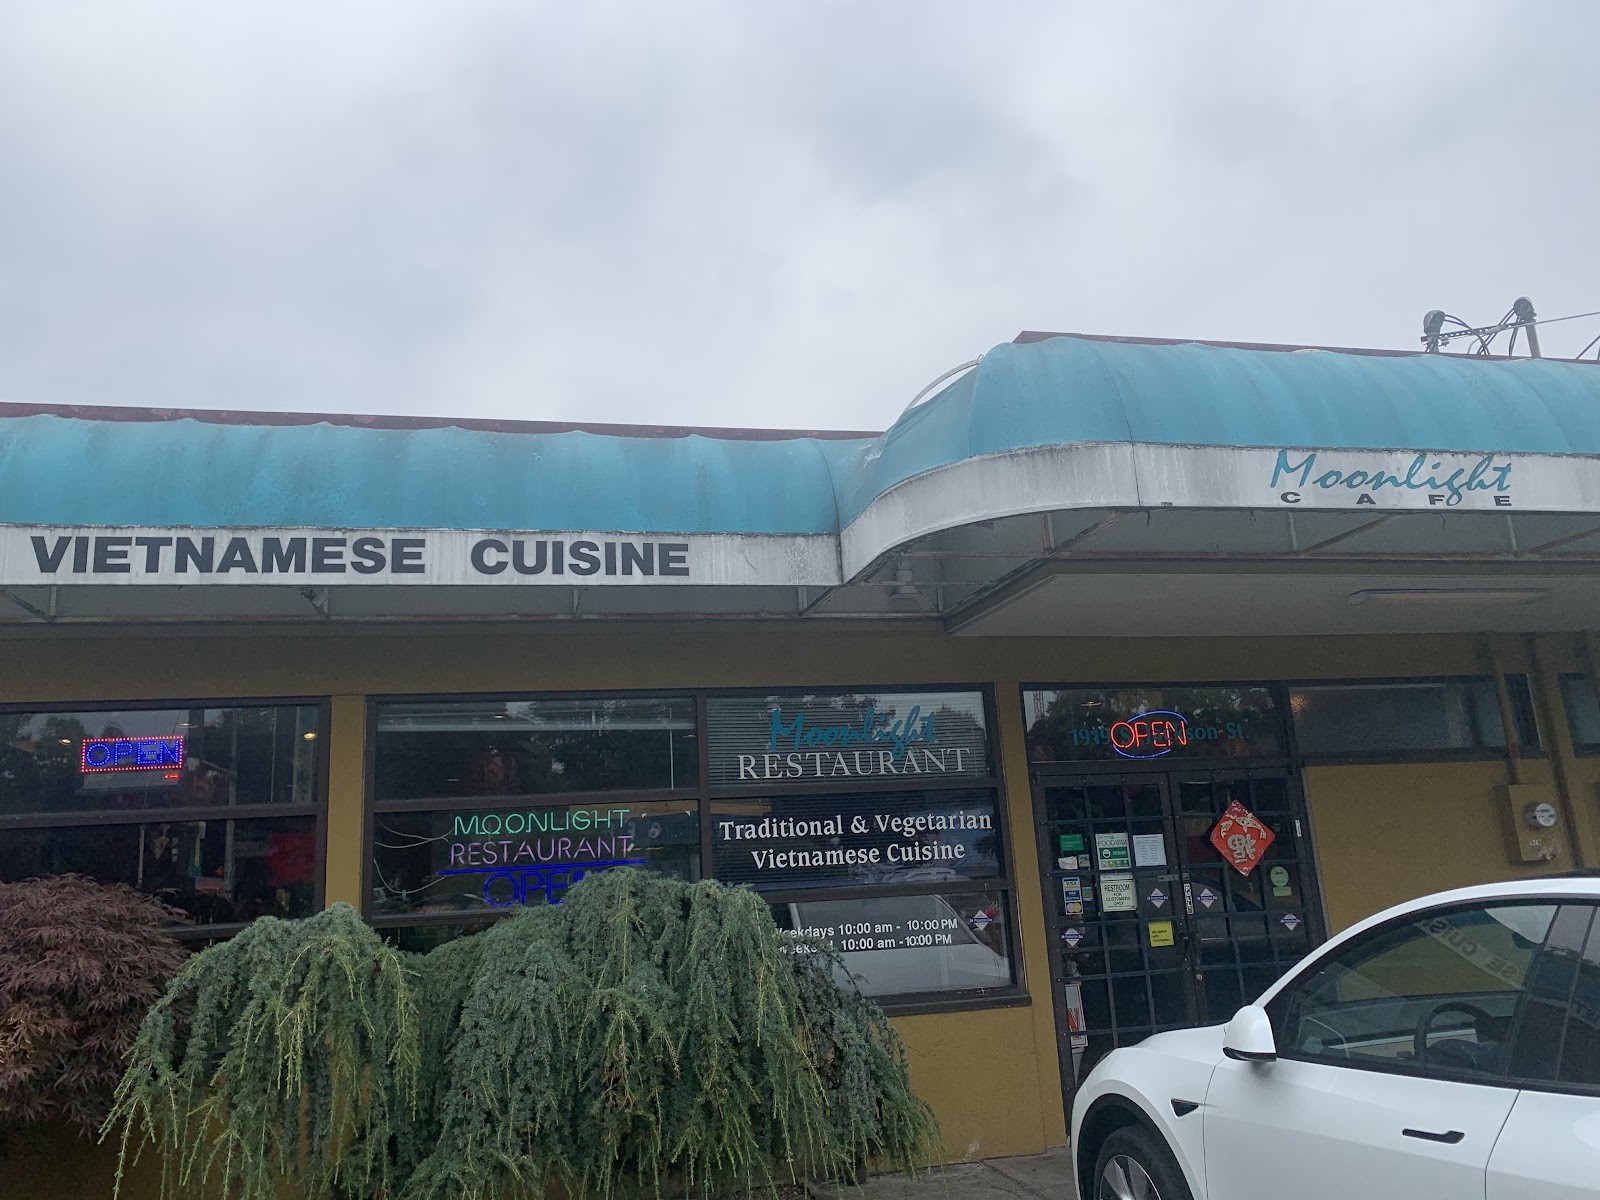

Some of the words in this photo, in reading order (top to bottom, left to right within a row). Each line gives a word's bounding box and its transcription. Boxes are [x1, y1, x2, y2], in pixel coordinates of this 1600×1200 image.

[1270, 449, 1512, 506] Moonlight
[31, 536, 426, 574] VIETNAMESE
[471, 538, 690, 577] CUISINE
[770, 704, 937, 760] Moonlight
[1071, 727, 1110, 747] 1919
[1225, 721, 1250, 740] St.
[1110, 720, 1187, 748] OPEN
[85, 740, 179, 767] OPEN
[737, 748, 971, 780] RESTAURANT
[454, 809, 631, 836] MOONLIGHT
[719, 815, 844, 841] Traditional
[851, 815, 869, 834] &
[875, 810, 993, 838] Vegetarian
[450, 835, 634, 866] RESTAURANT
[751, 847, 880, 870] Vietnamese
[887, 840, 966, 863] Cuisine
[483, 867, 603, 909] OPE
[1104, 883, 1130, 892] RESTROOM
[839, 922, 871, 935] 10:00
[875, 924, 893, 933] am
[906, 918, 939, 931] 10:00
[941, 918, 958, 930] PM
[841, 938, 874, 951] 10:00
[877, 939, 896, 948] am
[935, 932, 952, 945] PM
